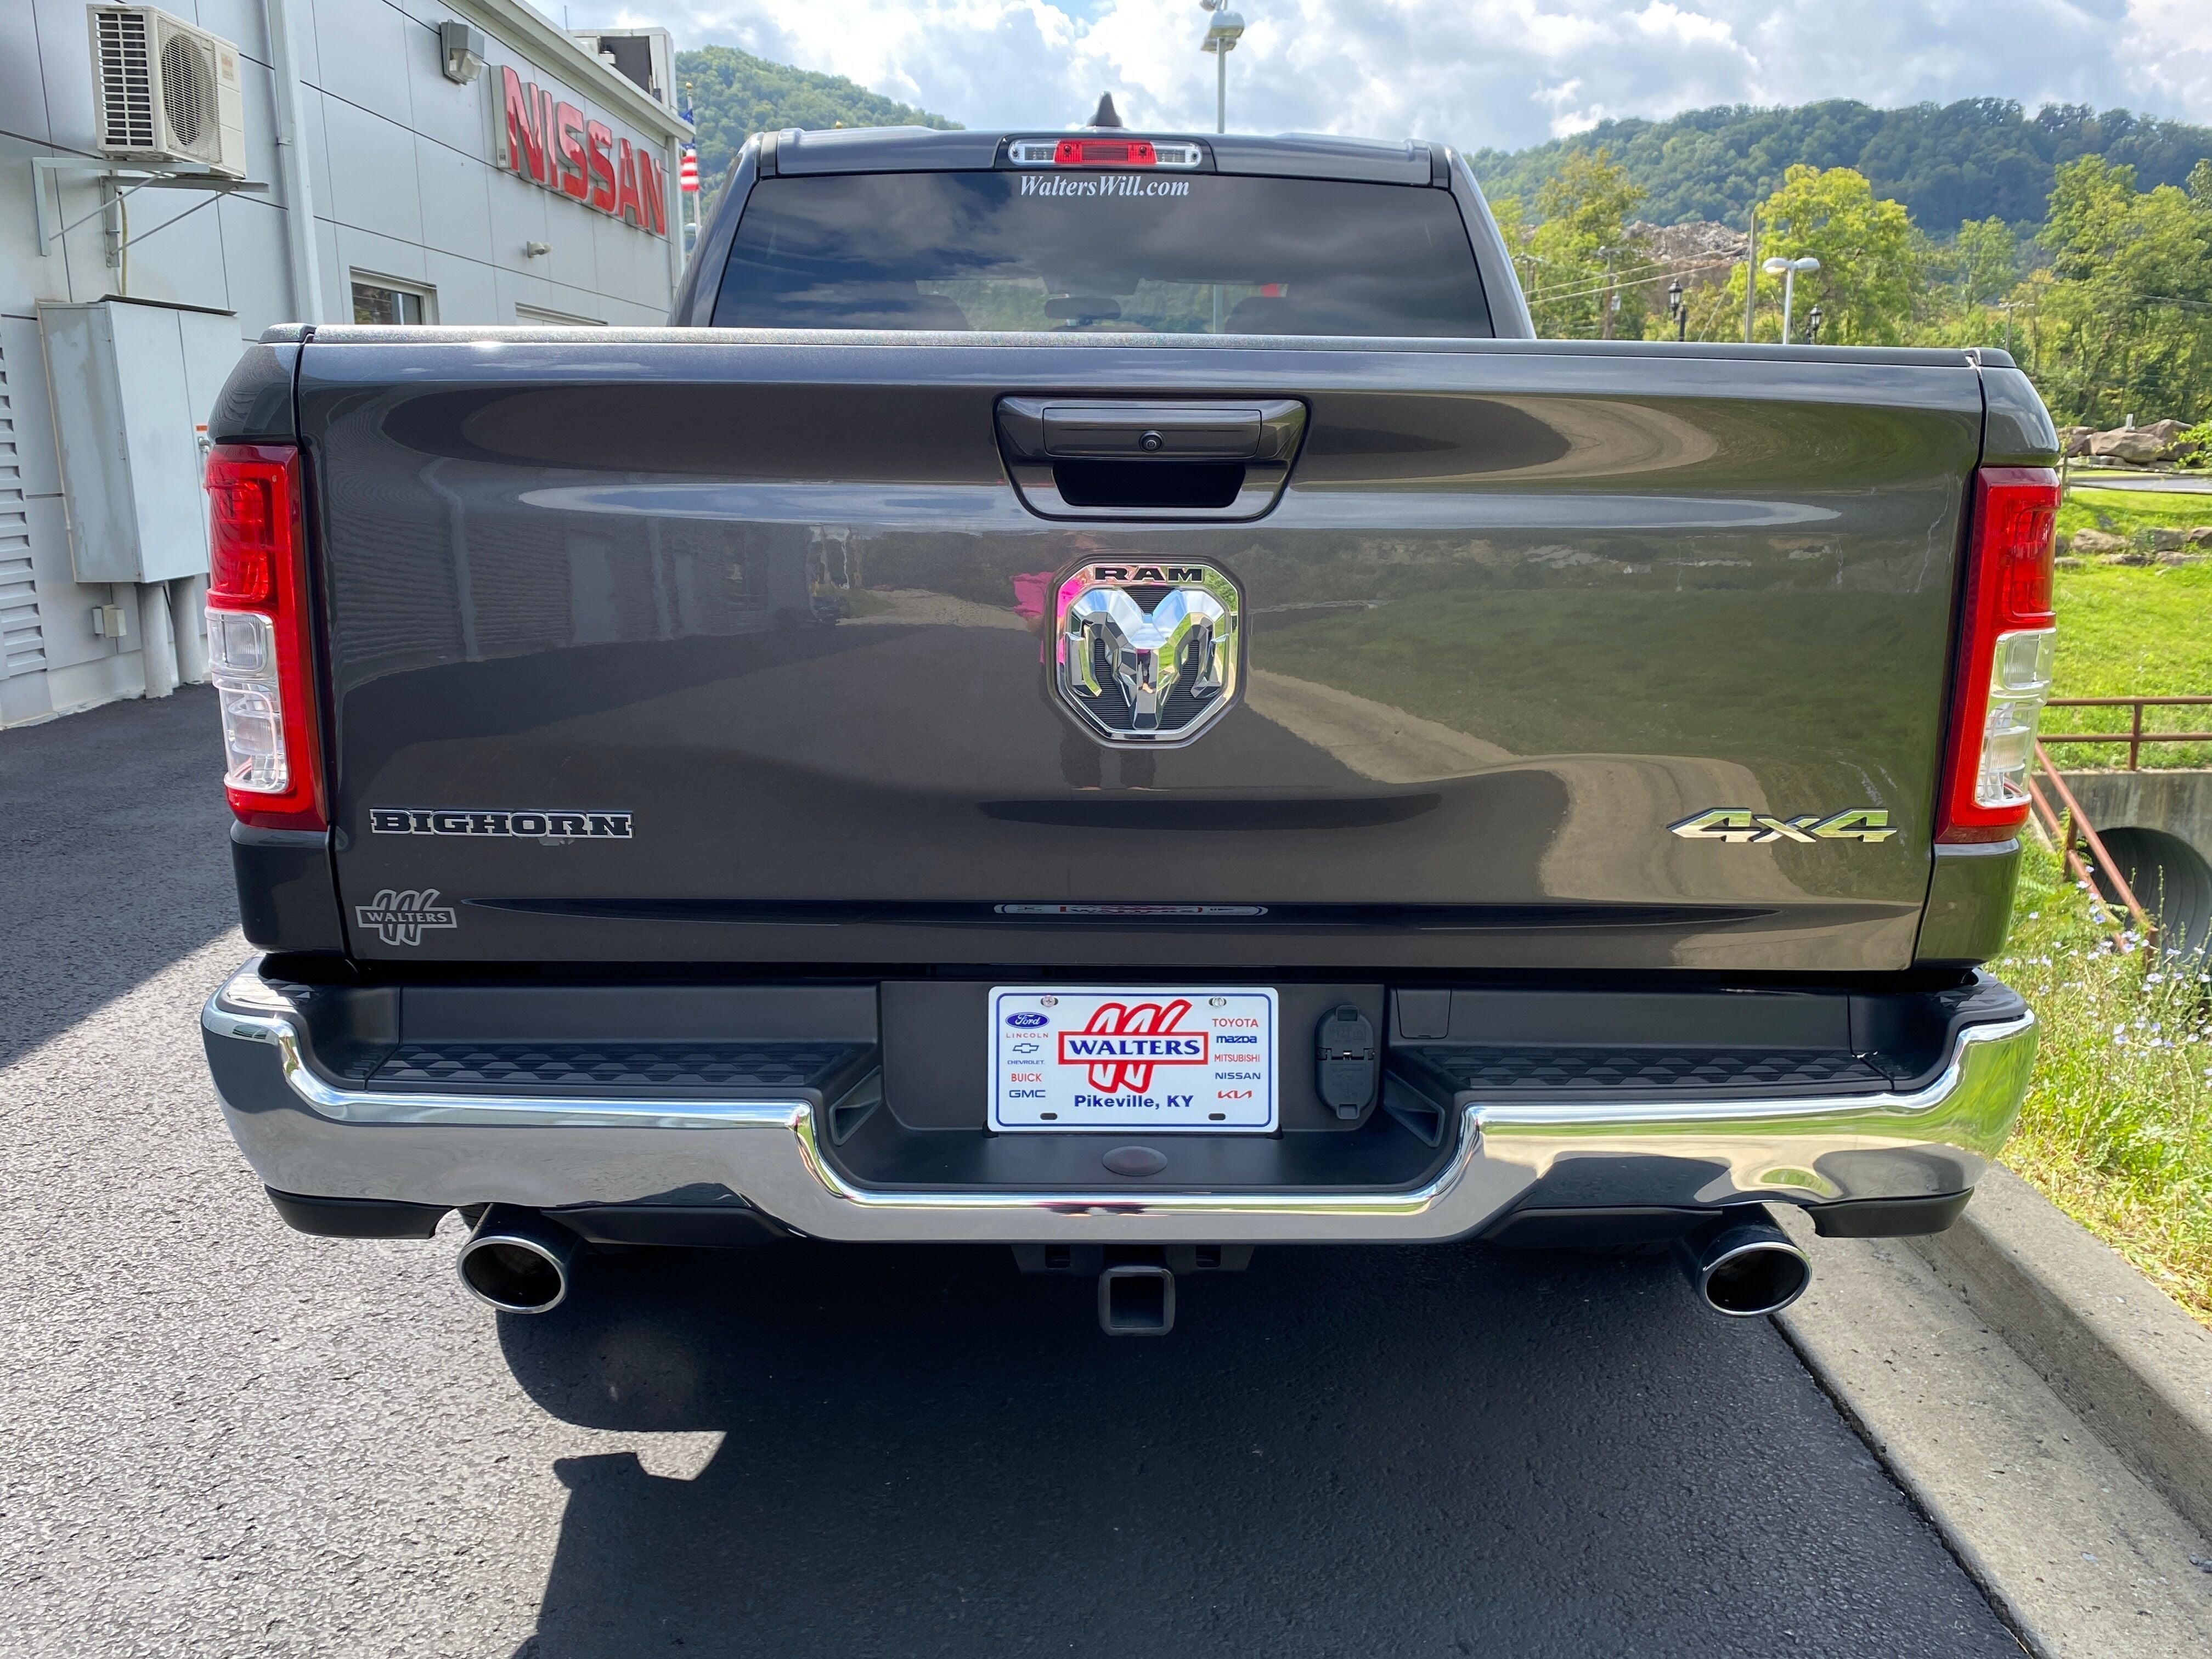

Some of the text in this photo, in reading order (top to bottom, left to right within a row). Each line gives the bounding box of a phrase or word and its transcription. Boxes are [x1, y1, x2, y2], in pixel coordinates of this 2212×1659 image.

[501, 65, 665, 236] NISSAN
[1020, 175, 1189, 196] WaltersWill.com
[1094, 567, 1203, 582] RAM
[369, 809, 634, 838] BIGHORN
[1666, 808, 1897, 843] 4x4
[366, 912, 448, 923] WALTERS
[1014, 1013, 1041, 1026] Ford
[1212, 1018, 1259, 1028] TOYOTA
[1068, 1040, 1200, 1055] WALTERS
[1214, 1053, 1260, 1062] MITSUBISHI
[1011, 1073, 1042, 1082] BUICK
[1009, 1090, 1046, 1098] GMC
[1074, 1095, 1194, 1109] Pikeville, KY
